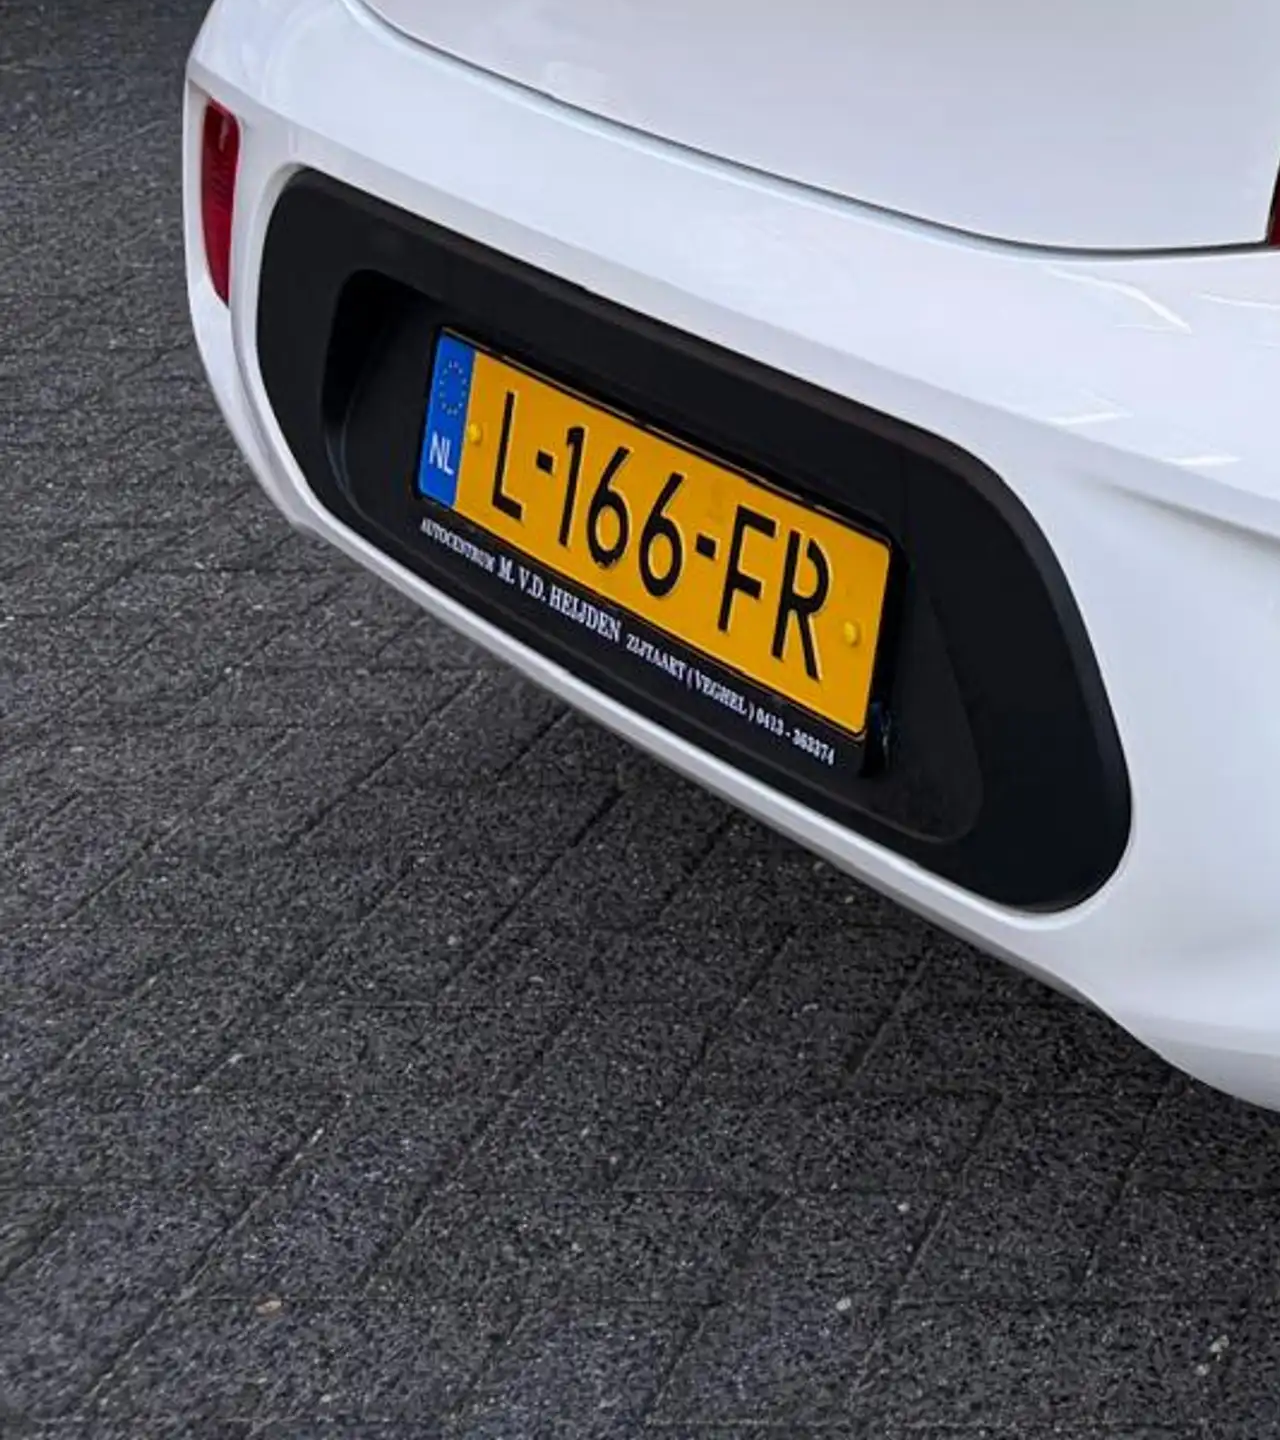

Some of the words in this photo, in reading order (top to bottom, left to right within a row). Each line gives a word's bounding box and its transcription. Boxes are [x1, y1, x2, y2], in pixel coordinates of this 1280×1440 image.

[429, 431, 455, 477] NL
[420, 518, 496, 574] AUTOCENTRUM
[497, 554, 516, 586] M.
[549, 584, 622, 643] HEIJDEN
[626, 633, 687, 681] ZIJTAART
[491, 390, 831, 682] L-166-FR
